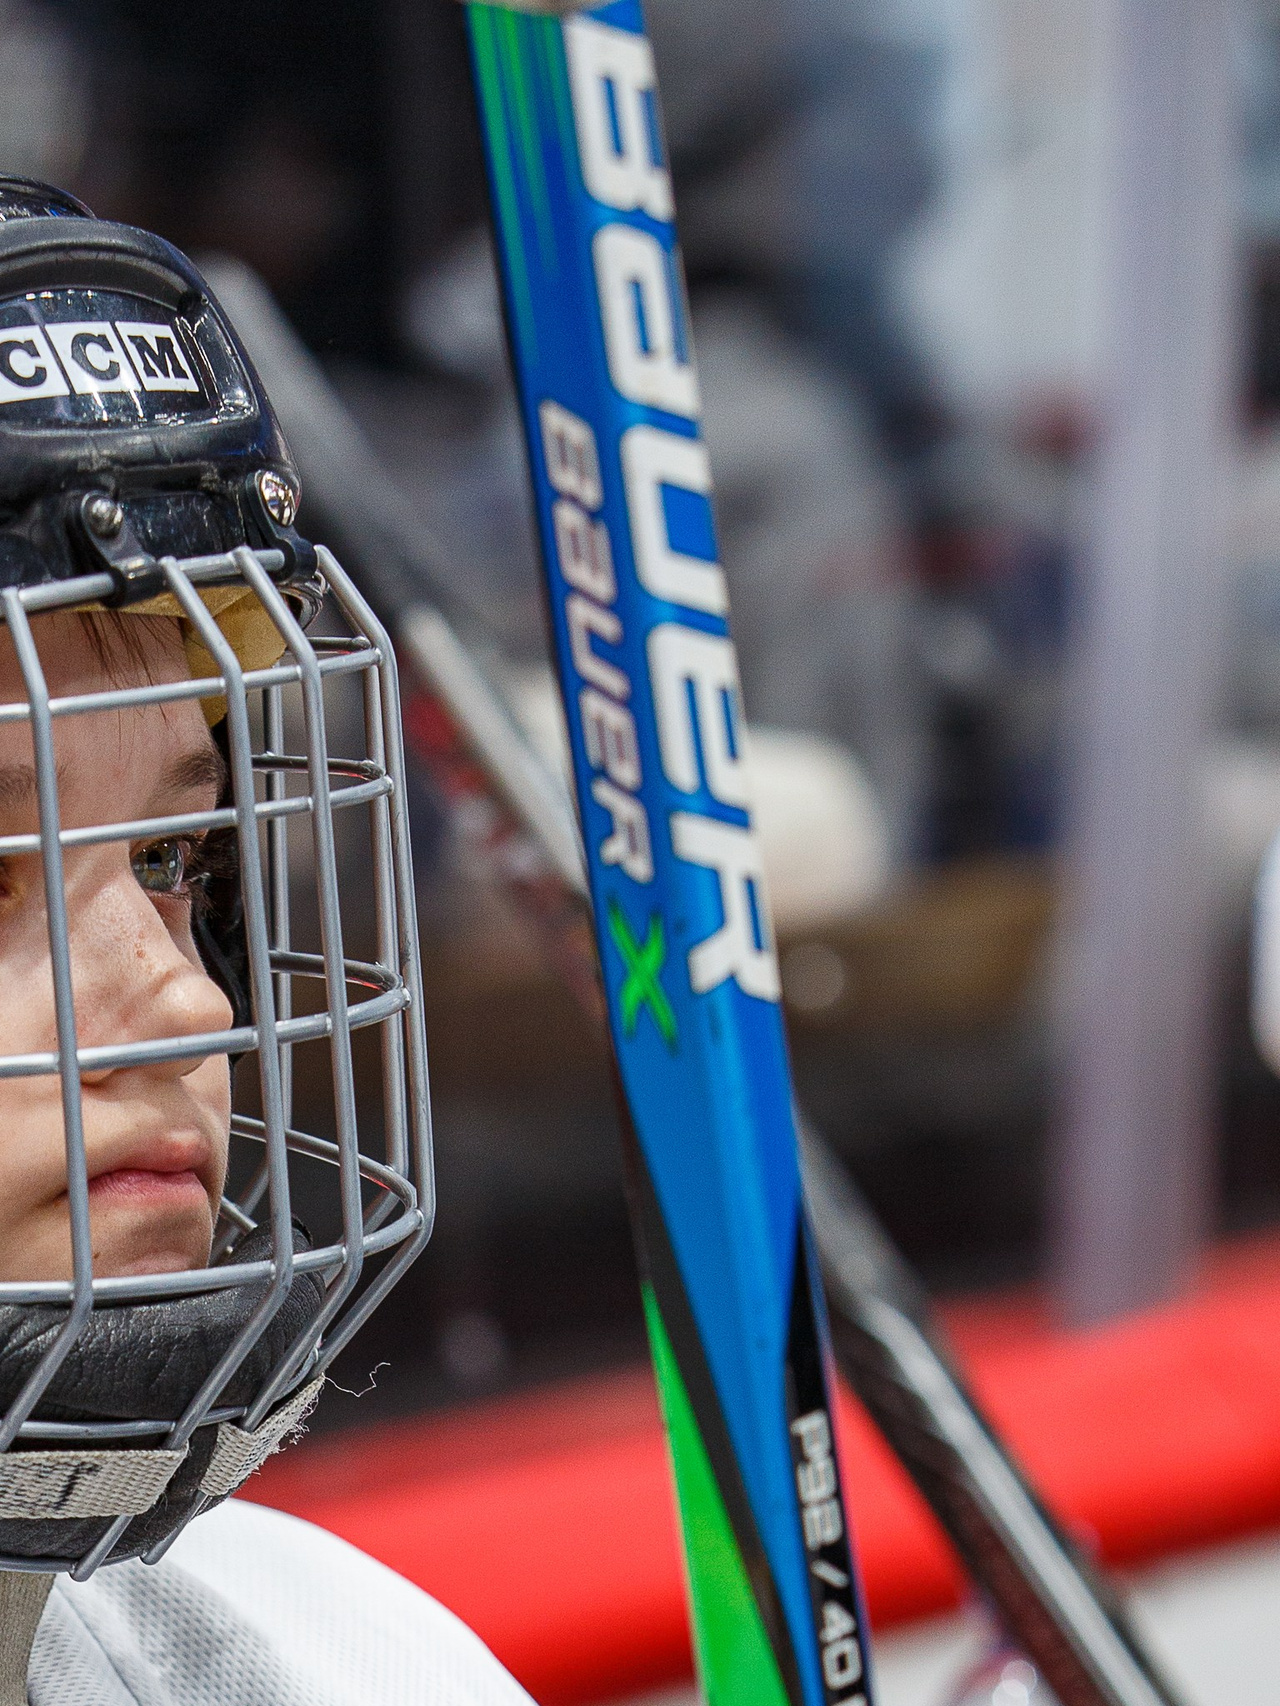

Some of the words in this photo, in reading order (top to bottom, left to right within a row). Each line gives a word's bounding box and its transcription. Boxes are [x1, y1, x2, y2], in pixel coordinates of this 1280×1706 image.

[539, 399, 652, 884] BAUER
[562, 13, 782, 1002] BAUER
[790, 1408, 844, 1550] P92
[819, 1601, 863, 1691] 40
